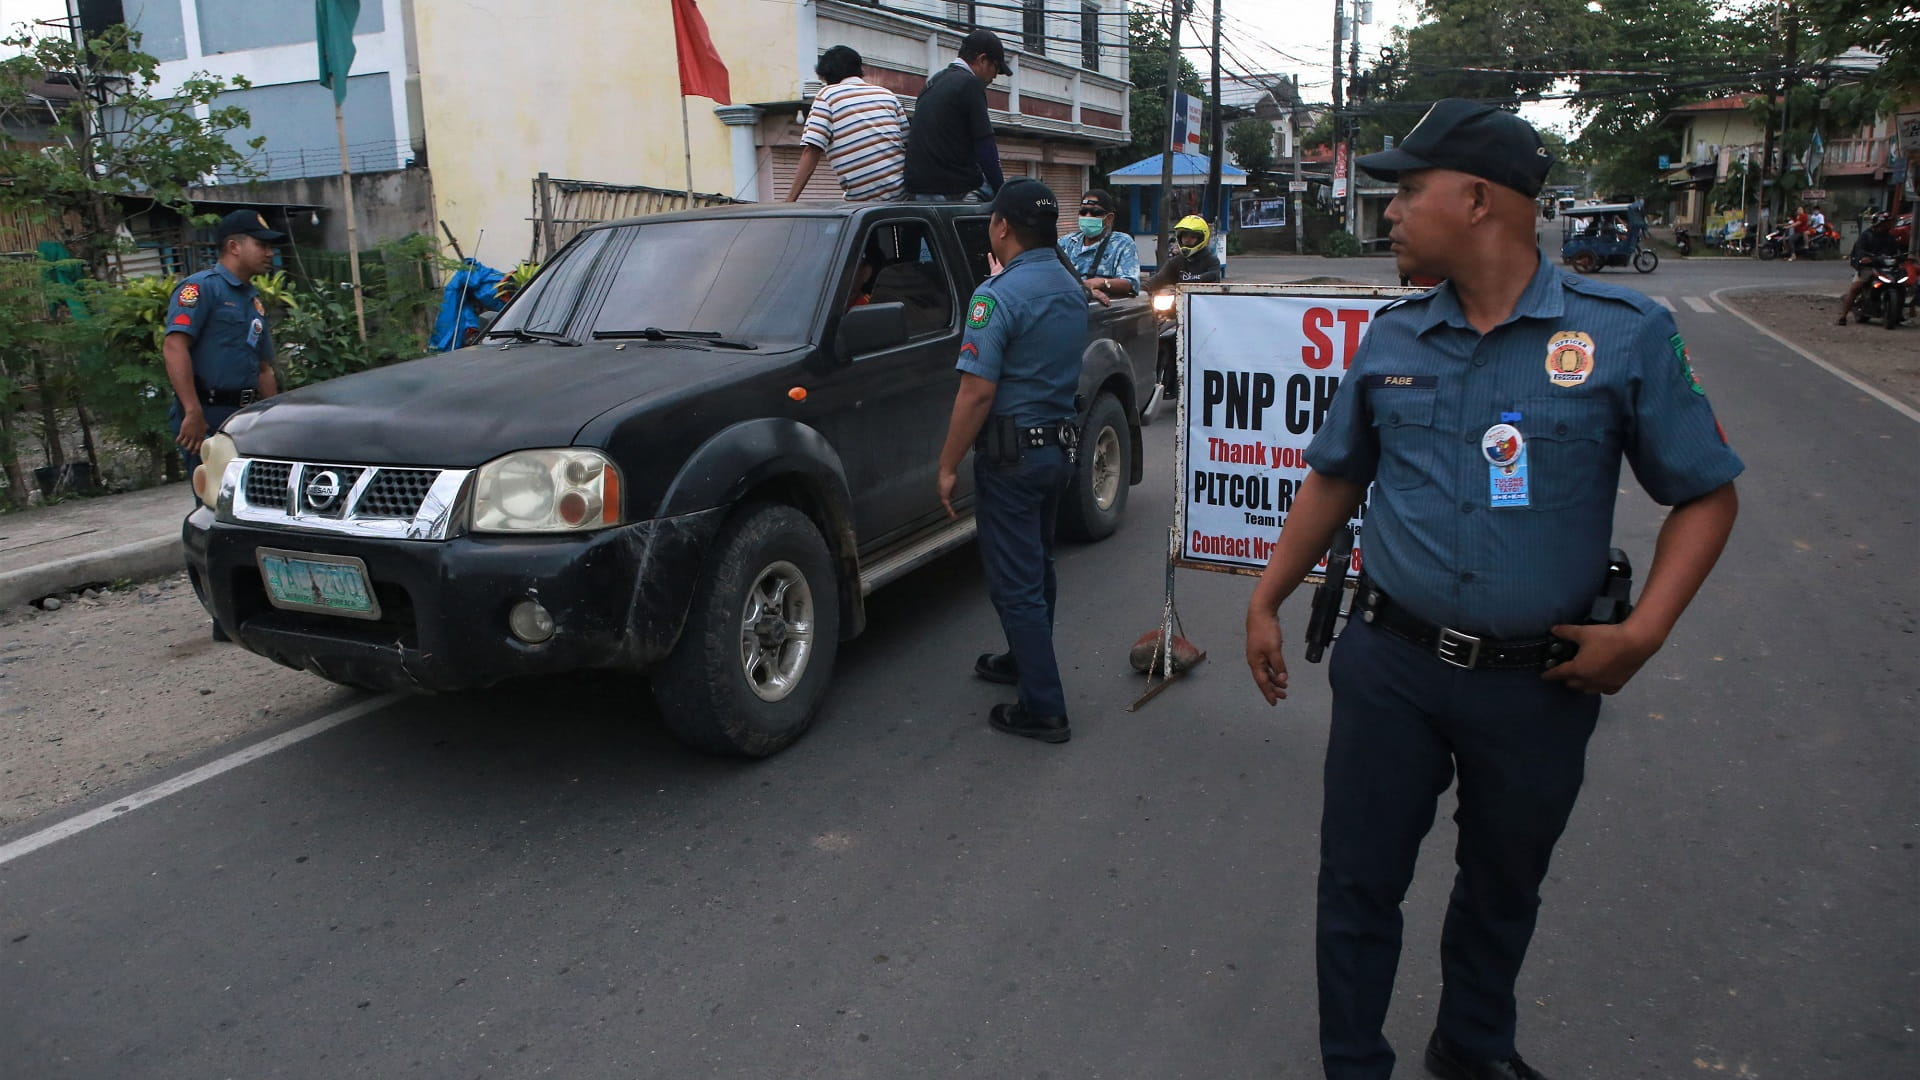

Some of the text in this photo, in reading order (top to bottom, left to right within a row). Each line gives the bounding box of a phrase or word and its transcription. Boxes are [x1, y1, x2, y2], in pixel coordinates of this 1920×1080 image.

[1302, 307, 1368, 369] ST
[1555, 339, 1587, 348] OFFICER
[1384, 376, 1413, 385] FABE
[1203, 370, 1339, 435] PNP CH
[1208, 437, 1307, 469] Thank you
[1195, 471, 1271, 511] PLTCOL
[1244, 512, 1275, 526] Team
[1192, 530, 1250, 558] Contact
